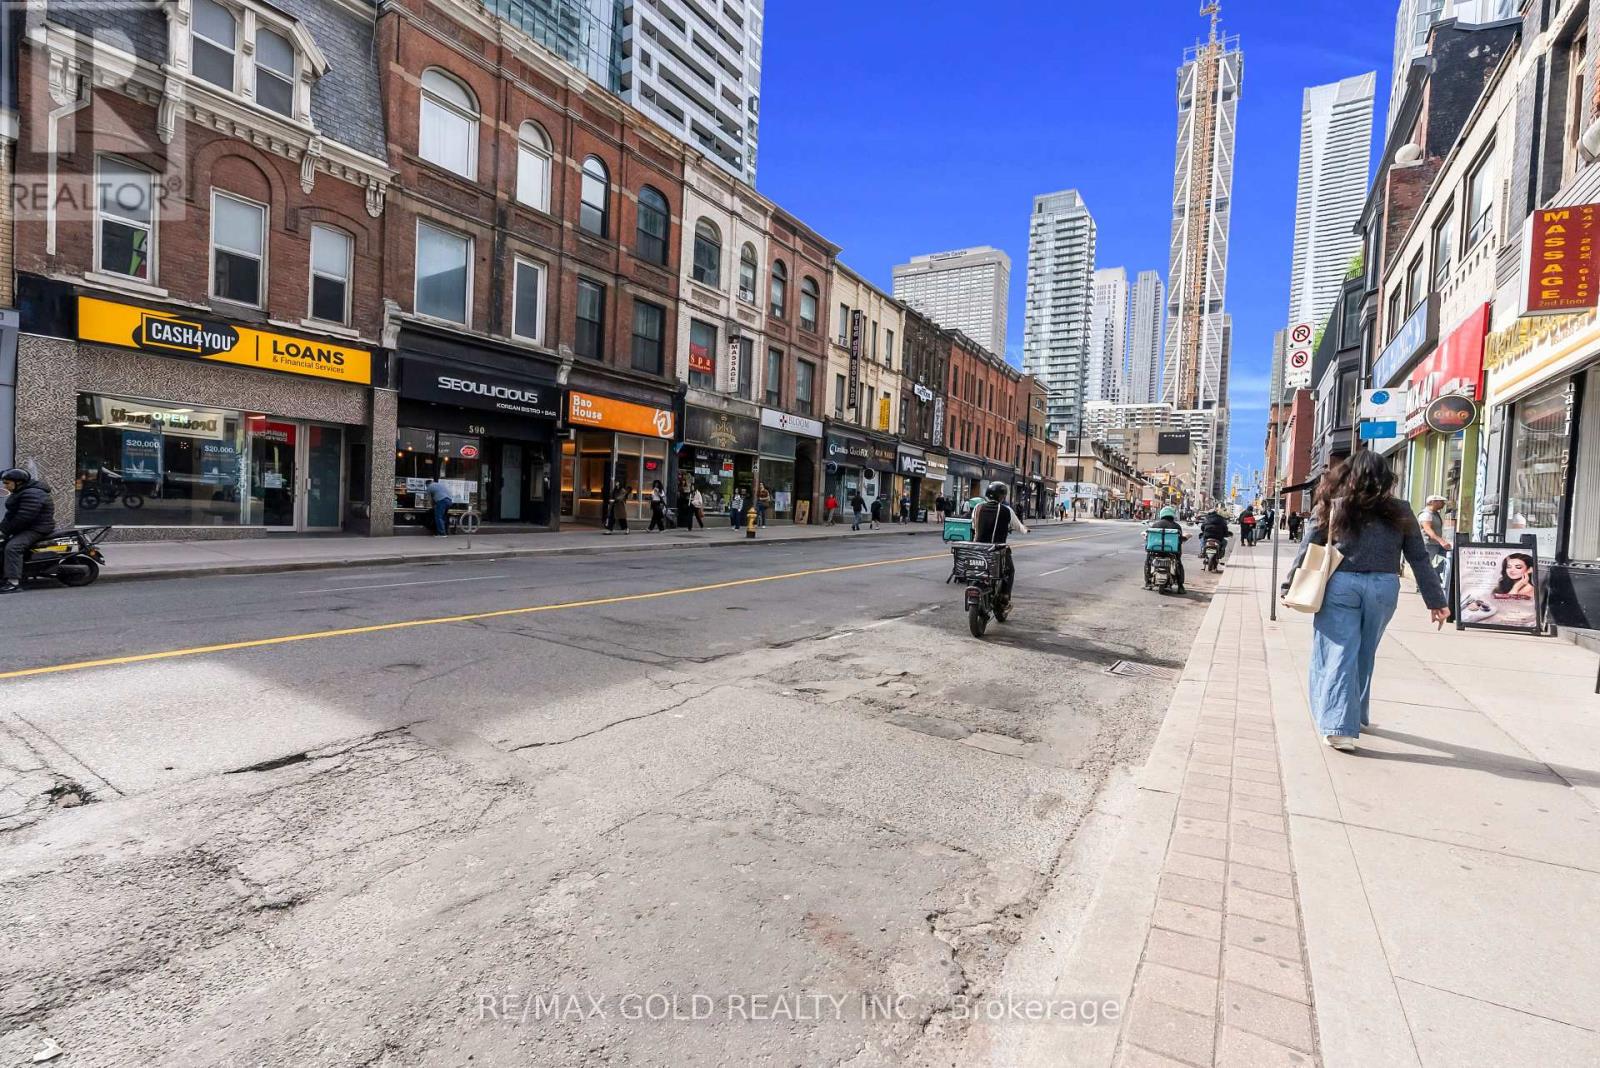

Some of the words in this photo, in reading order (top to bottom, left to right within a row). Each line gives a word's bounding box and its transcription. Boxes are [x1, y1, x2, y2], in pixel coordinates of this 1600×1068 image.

[1540, 210, 1570, 299] MASSAGE
[1560, 298, 1585, 306] Floor
[272, 340, 345, 366] LOANS
[272, 355, 279, 363] &
[281, 356, 314, 369] Financial
[315, 362, 345, 374] Services
[730, 344, 738, 383] MASSAGE
[437, 376, 539, 404] SEOULICIOUS
[496, 402, 520, 411] KOREAN
[521, 406, 540, 414] BISTRO
[573, 394, 592, 408] Bao
[152, 412, 189, 424] OPEN
[573, 405, 603, 420] House
[469, 425, 485, 434] 590
[1560, 449, 1569, 496] 571
